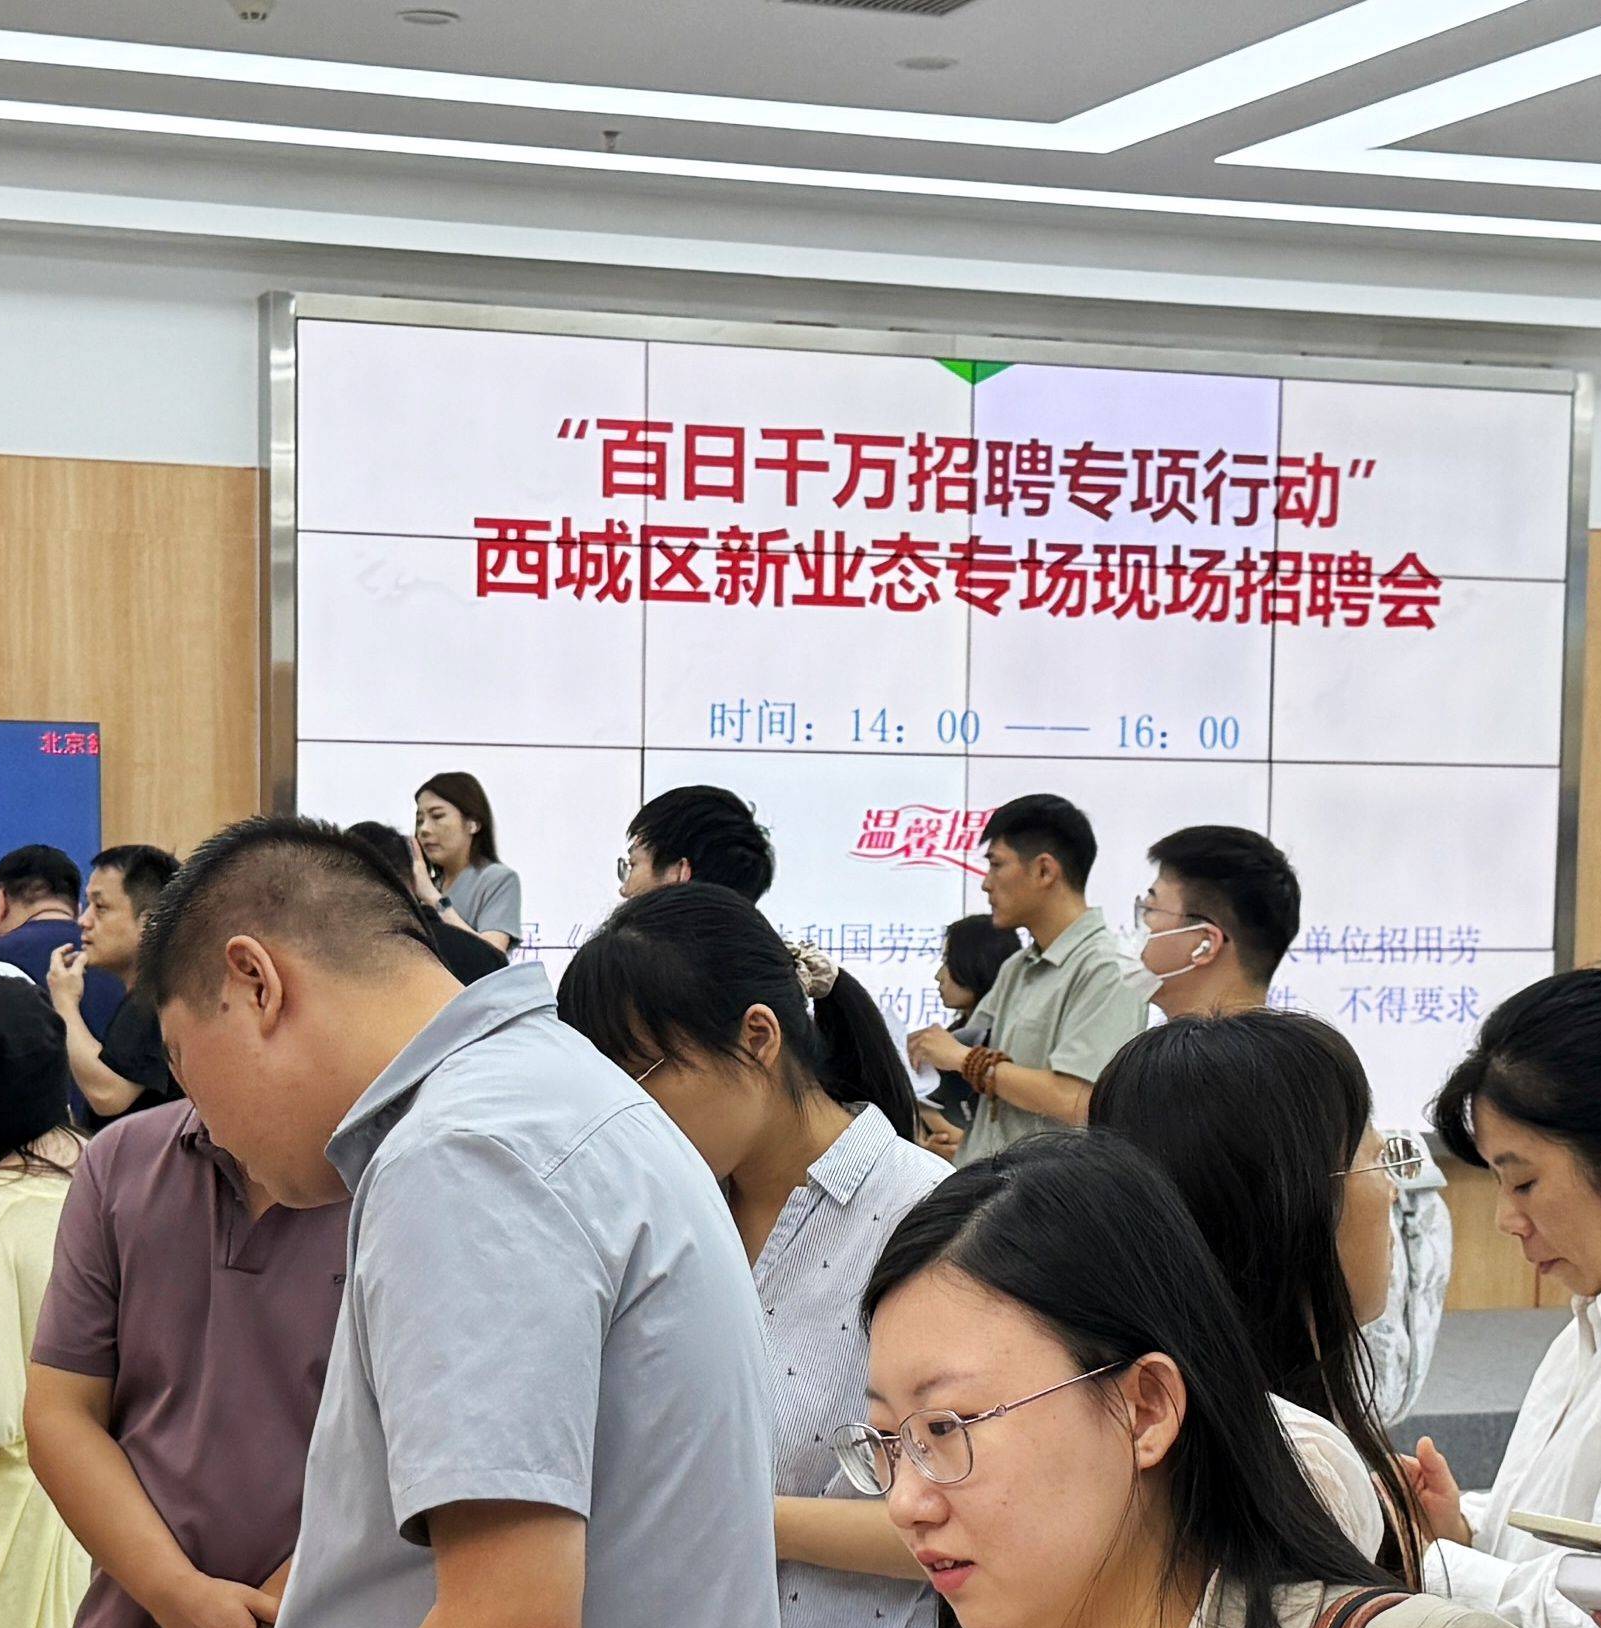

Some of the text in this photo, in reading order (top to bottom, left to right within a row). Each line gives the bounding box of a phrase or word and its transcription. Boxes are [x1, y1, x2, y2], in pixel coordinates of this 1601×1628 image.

[555, 416, 1377, 529] “百日千万招聘专项行动”
[473, 515, 1443, 632] 西城区新业态专场现场招聘会
[1339, 985, 1482, 1025] 不得要求
